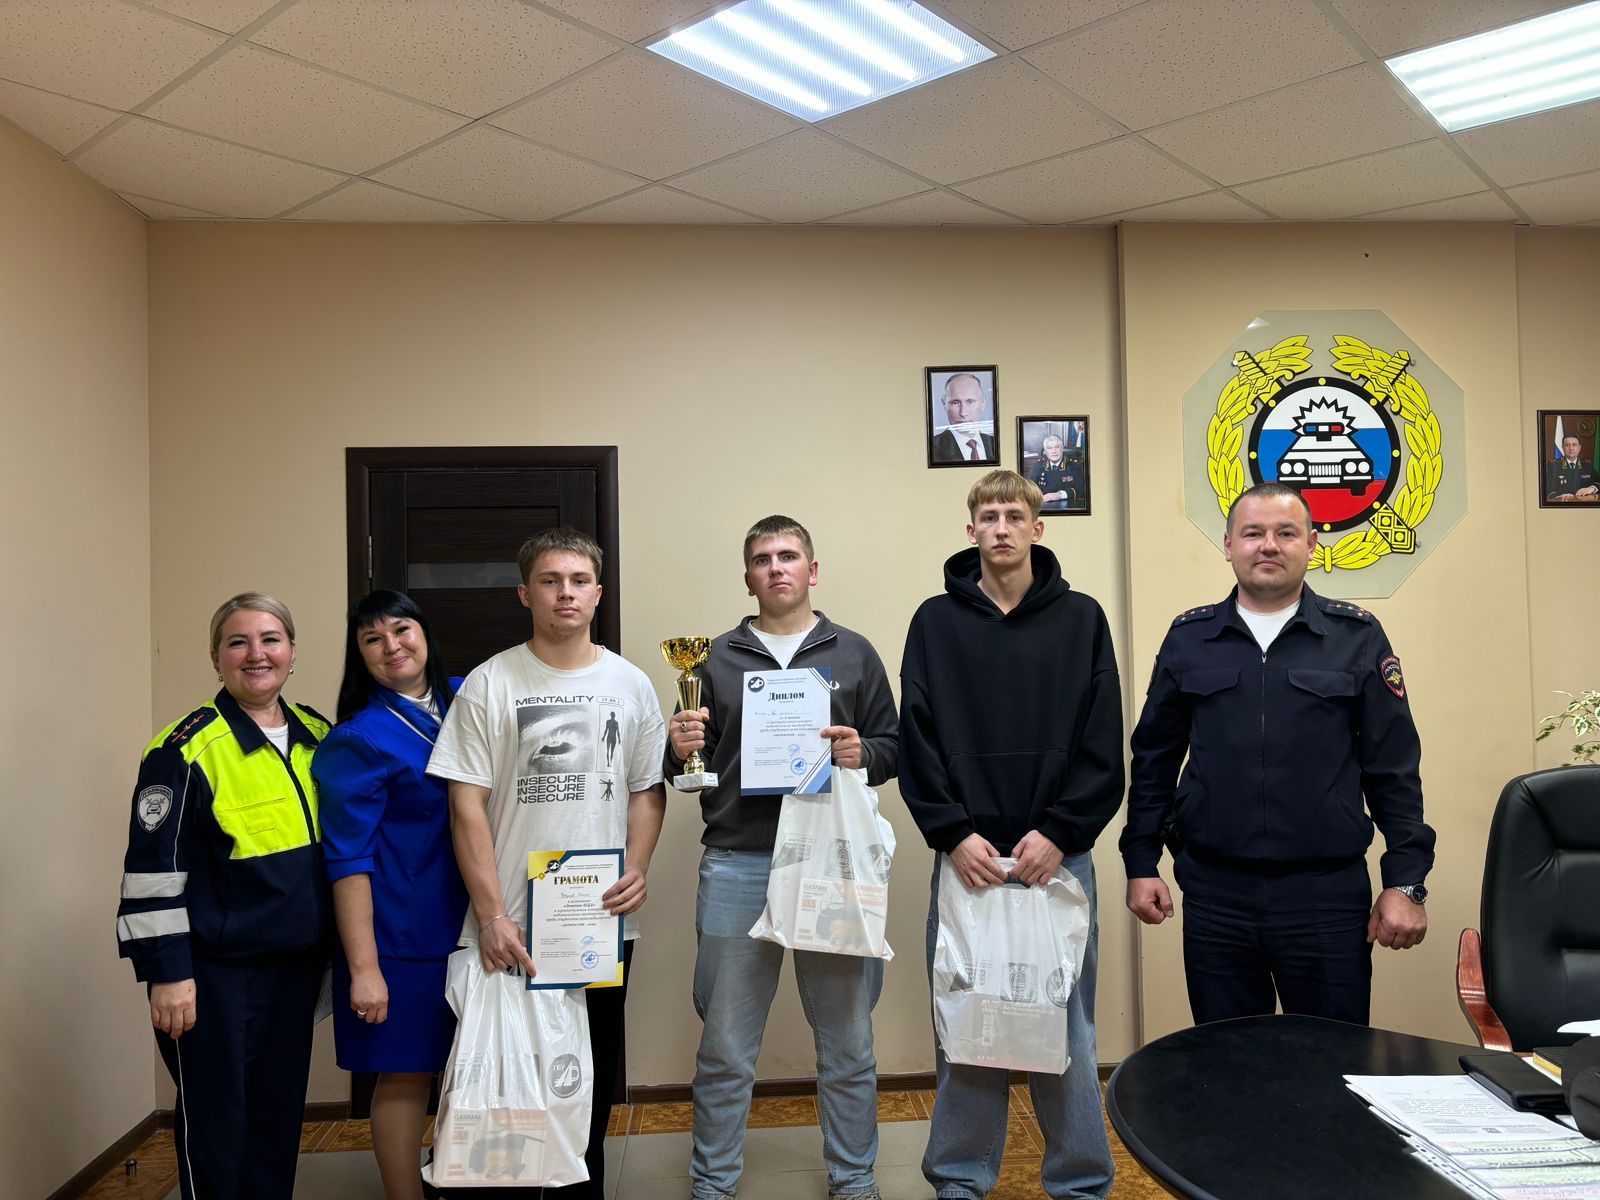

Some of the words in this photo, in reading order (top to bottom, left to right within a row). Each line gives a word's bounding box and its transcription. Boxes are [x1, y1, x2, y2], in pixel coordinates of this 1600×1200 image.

[515, 695, 594, 706] MENTALITY
[768, 692, 805, 701] Диплом
[517, 774, 586, 787] INSECURE
[517, 783, 585, 796] INSECURE
[554, 875, 599, 885] ГРАМОТА
